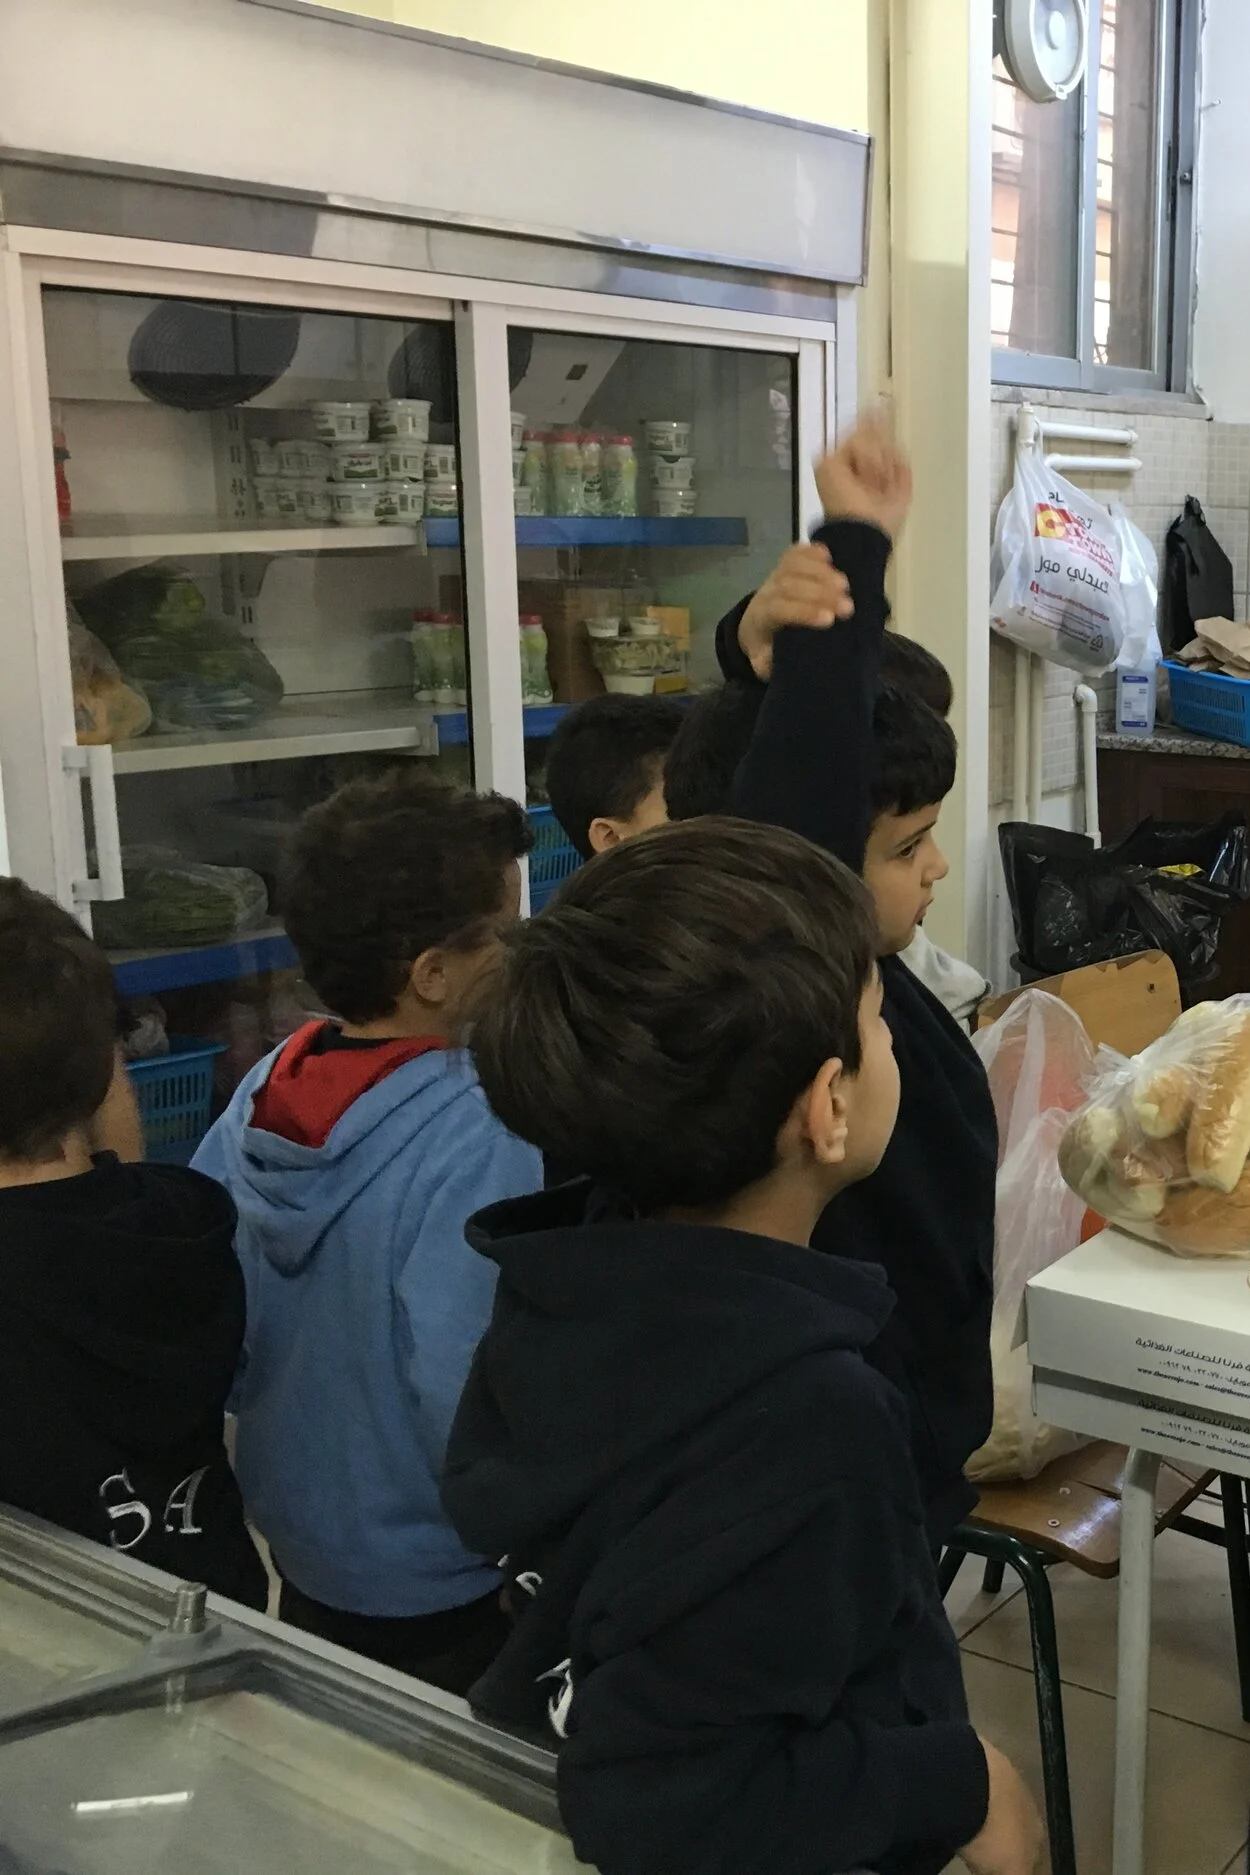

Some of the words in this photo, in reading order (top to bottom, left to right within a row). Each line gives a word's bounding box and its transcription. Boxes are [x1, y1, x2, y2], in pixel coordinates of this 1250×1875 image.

[1034, 556, 1060, 573] مول
[1135, 1337, 1173, 1353] الغذائية
[1174, 1347, 1222, 1365] للصناعات
